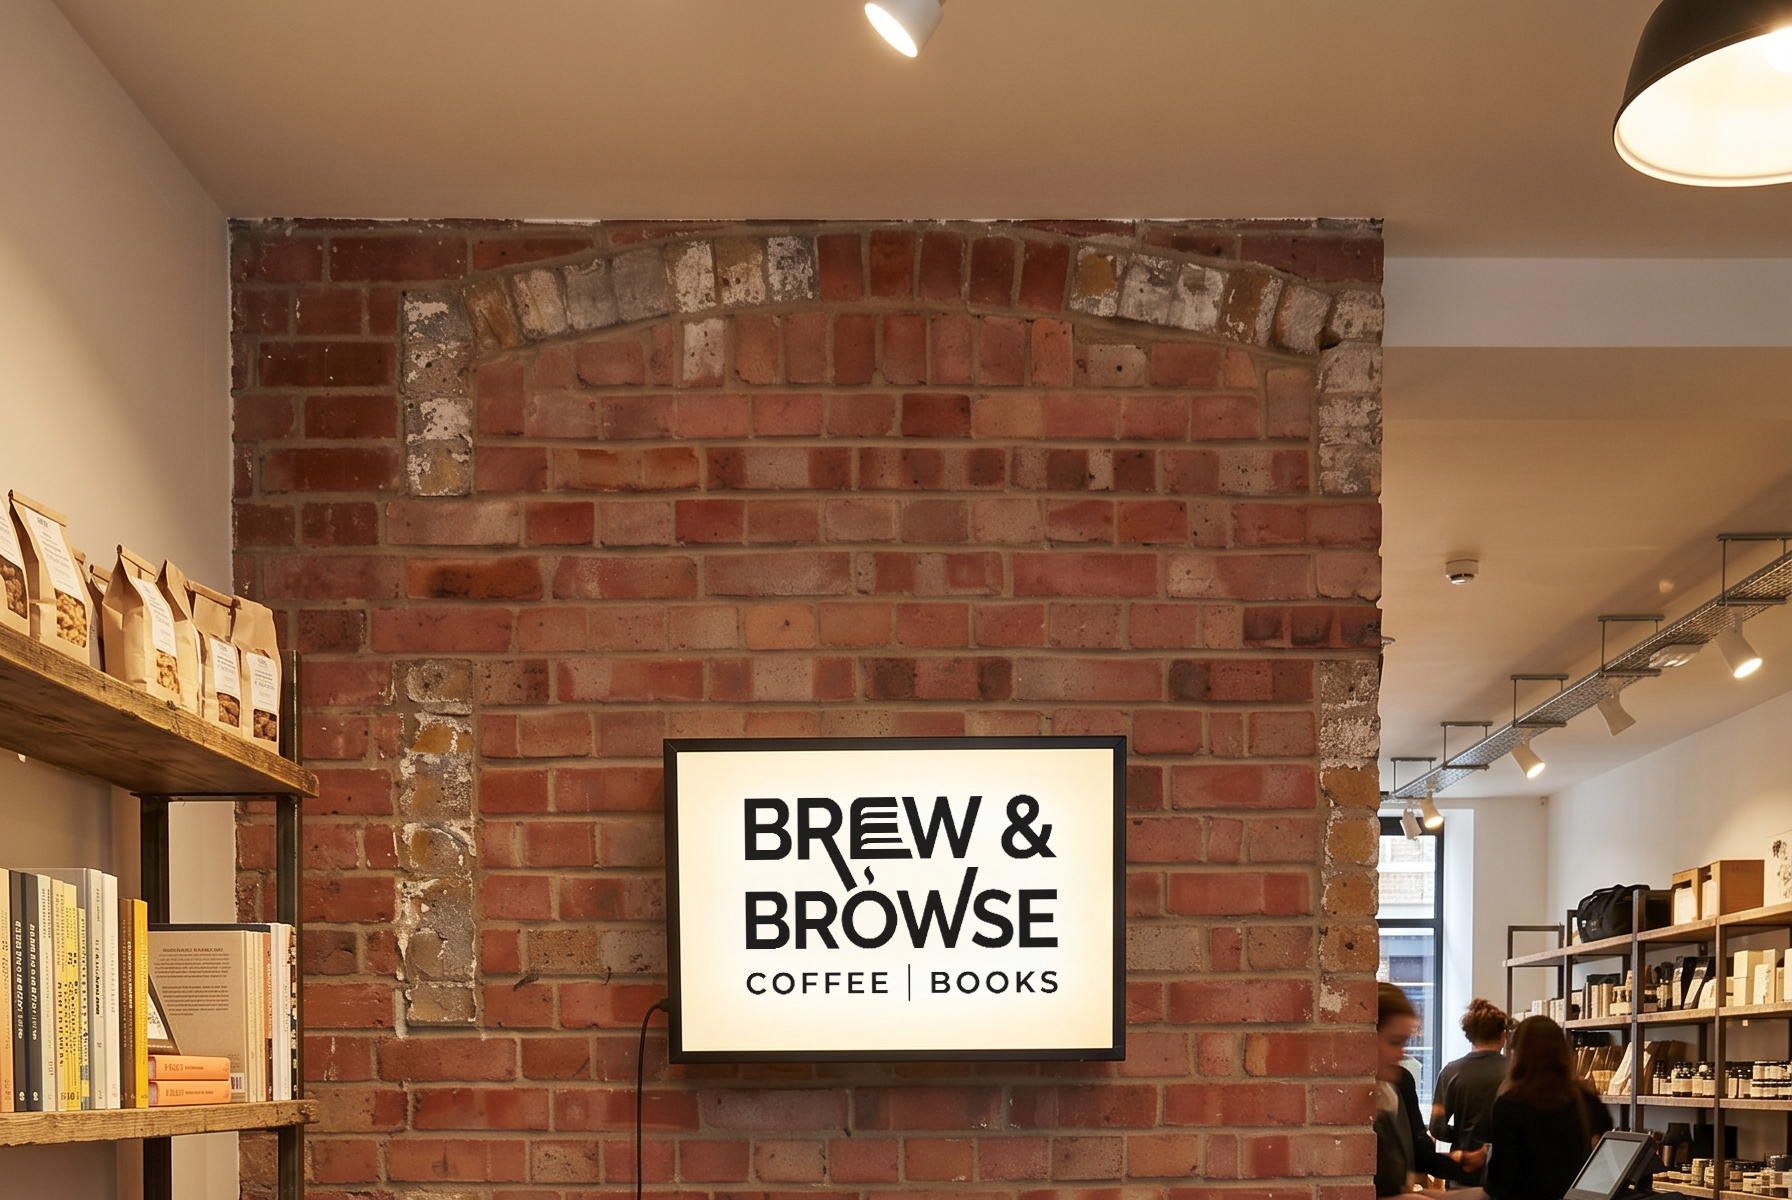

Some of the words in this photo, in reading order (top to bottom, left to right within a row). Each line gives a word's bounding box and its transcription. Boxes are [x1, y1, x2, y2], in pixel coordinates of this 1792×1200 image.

[744, 796, 983, 892] BREW
[1001, 794, 1057, 859] &
[745, 867, 1059, 950] BROWSE
[746, 972, 889, 995] COFFEE
[930, 971, 1059, 994] BOOKS
